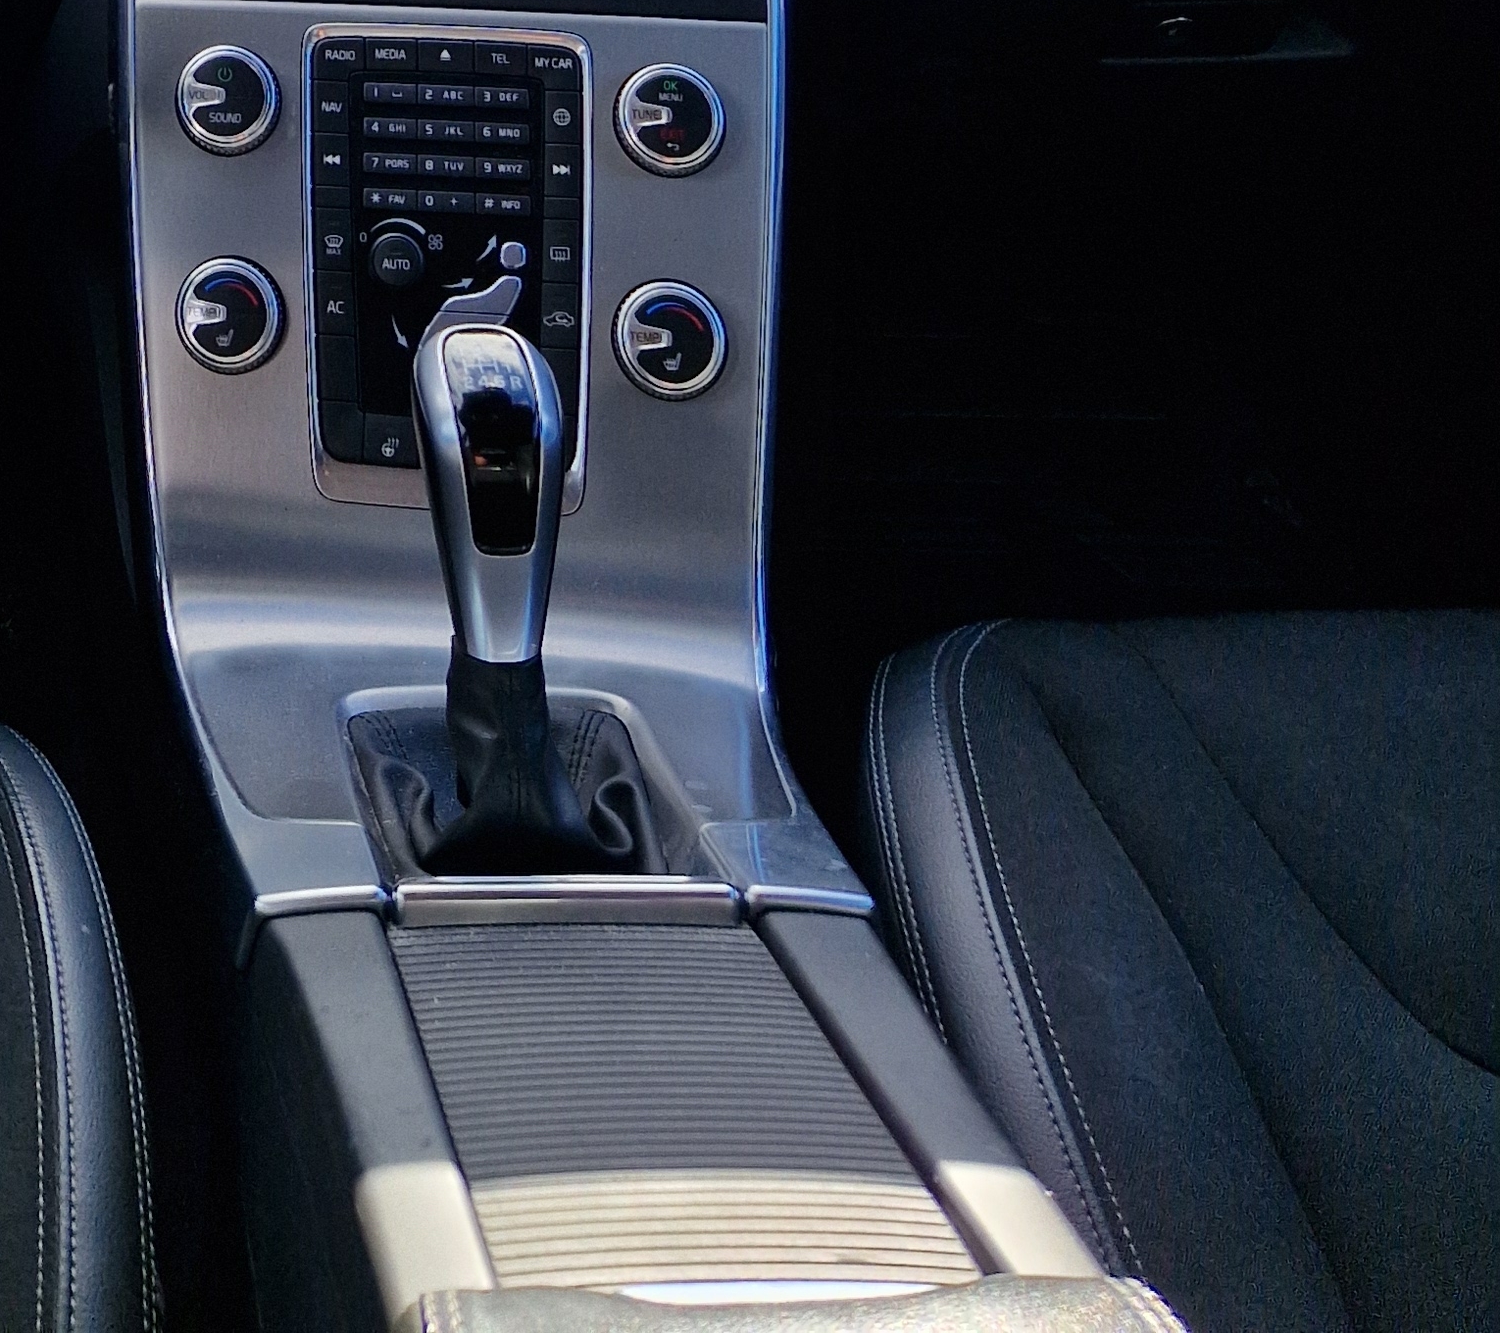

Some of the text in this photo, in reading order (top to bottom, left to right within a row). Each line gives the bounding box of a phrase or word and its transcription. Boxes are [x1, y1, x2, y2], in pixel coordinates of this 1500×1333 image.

[325, 49, 356, 61] RADIO
[375, 48, 407, 60] MEDIA
[491, 53, 510, 64] TEL
[534, 56, 573, 69] MY CAR
[663, 80, 678, 91] OK
[424, 89, 464, 100] 2 ABC
[483, 91, 520, 102] 3 DEF
[658, 92, 683, 102] MENU
[321, 100, 342, 113] NAV
[208, 111, 242, 124] SOUND
[632, 108, 661, 120] TUNE
[371, 121, 406, 133] 4 GHI
[425, 124, 464, 136] 5 JKL
[482, 126, 521, 138] 6 MNO
[371, 157, 410, 169] 7 PQRS
[425, 160, 464, 171] 8 TUV
[483, 162, 523, 174] 9 WXYZ
[388, 194, 406, 204] FAV
[501, 200, 521, 210] INFO
[326, 247, 342, 255] MAX
[382, 258, 410, 271] AUTO
[327, 300, 345, 314] AC
[630, 331, 660, 343] TEMP
[509, 375, 523, 389] R
